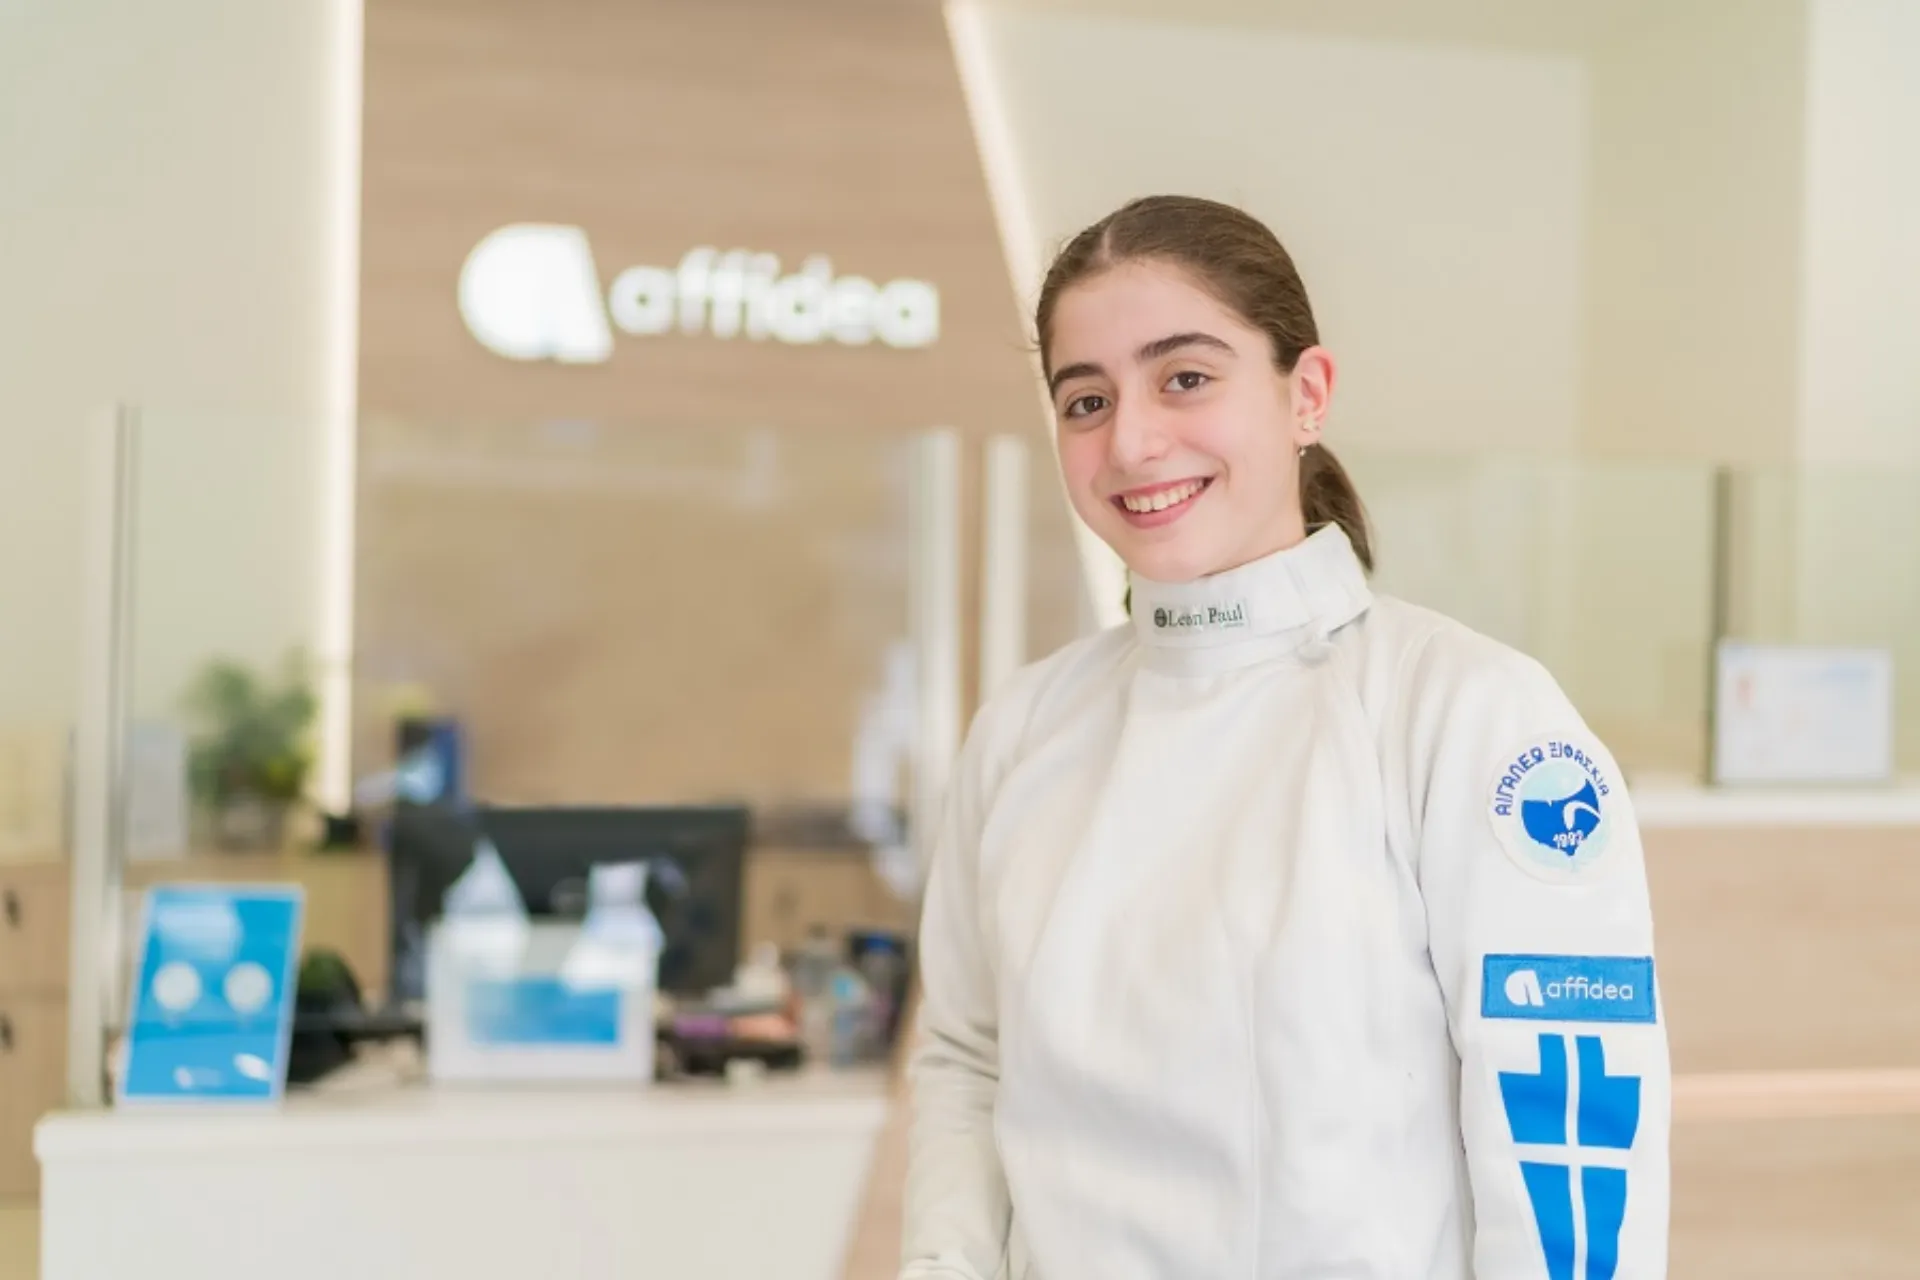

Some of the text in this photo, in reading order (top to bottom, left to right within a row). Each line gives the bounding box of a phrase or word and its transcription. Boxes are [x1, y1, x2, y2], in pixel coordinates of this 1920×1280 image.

[609, 245, 938, 348] affidea
[1168, 603, 1243, 627] Leon Paul
[1546, 977, 1634, 1000] affidea
